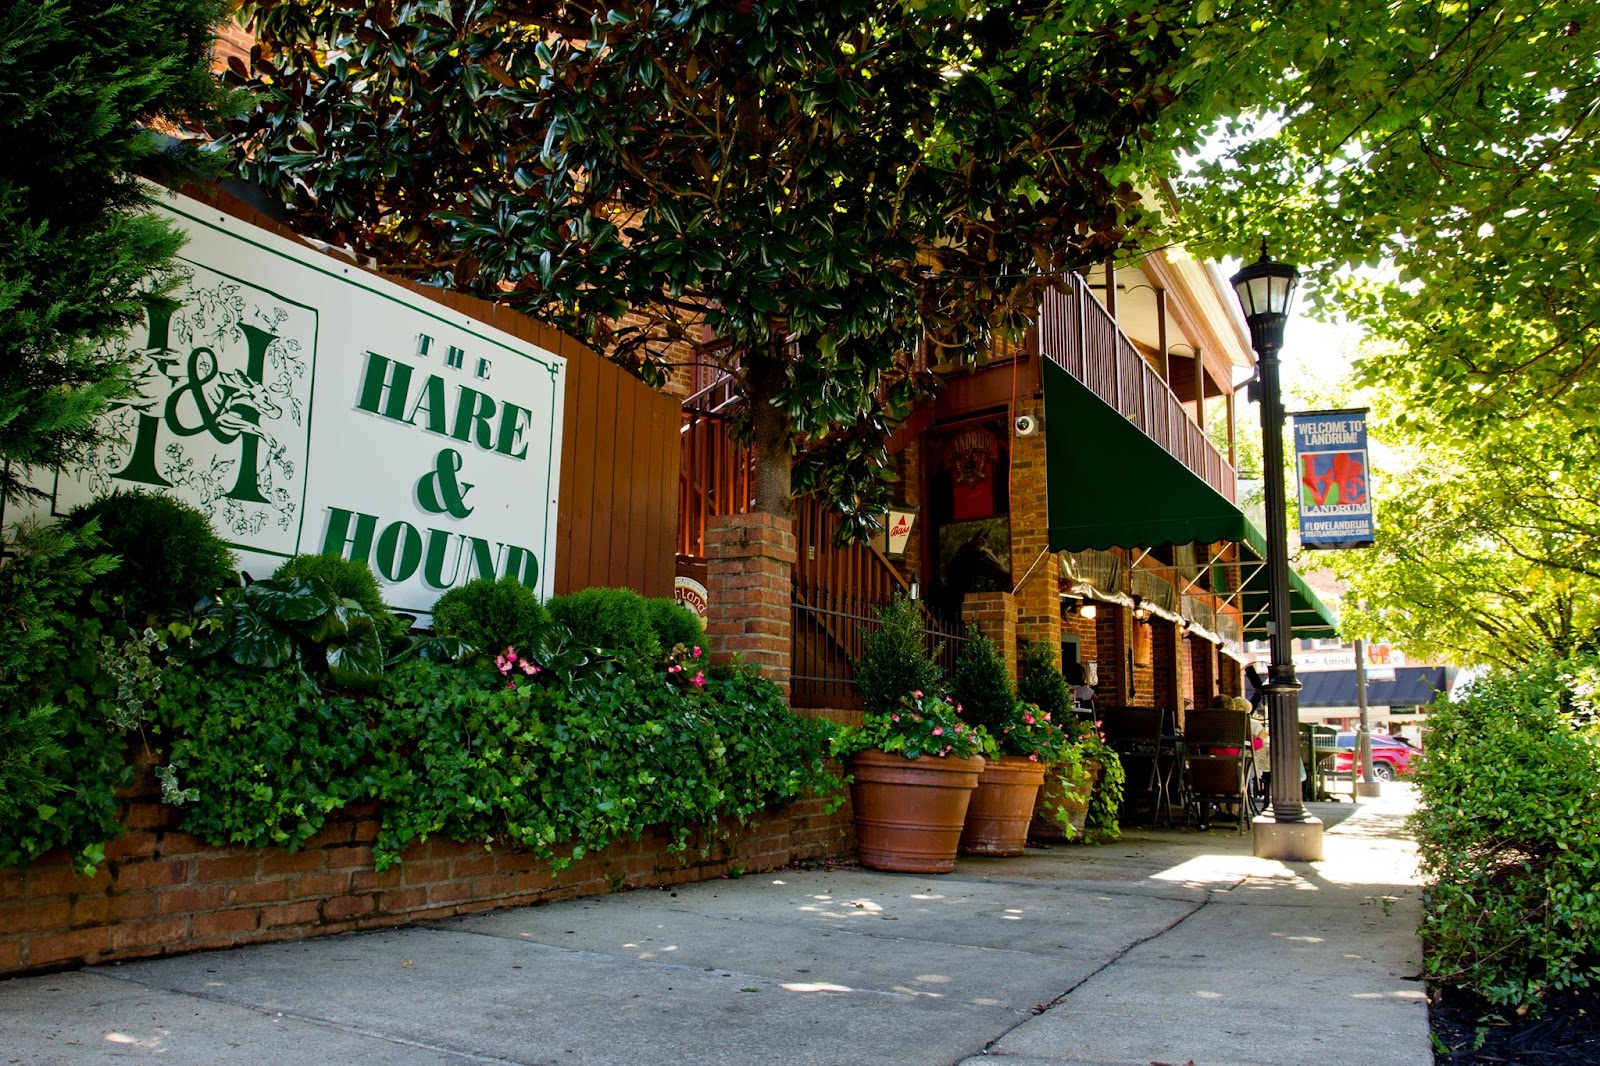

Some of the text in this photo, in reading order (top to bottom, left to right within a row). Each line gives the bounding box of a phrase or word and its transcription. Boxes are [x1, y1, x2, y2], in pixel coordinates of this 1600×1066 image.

[415, 333, 492, 380] THE
[355, 350, 533, 461] HARE
[1299, 420, 1363, 435] WELCOME TO
[953, 432, 992, 453] ANDRUM
[1305, 432, 1357, 446] LANDRUM!
[416, 448, 475, 519] &
[1304, 504, 1367, 514] LANDRUM
[890, 525, 911, 537] Bass
[1304, 520, 1369, 531] #LOVELANDRUM
[320, 506, 538, 592] HOUND
[1323, 656, 1351, 665] Amish
